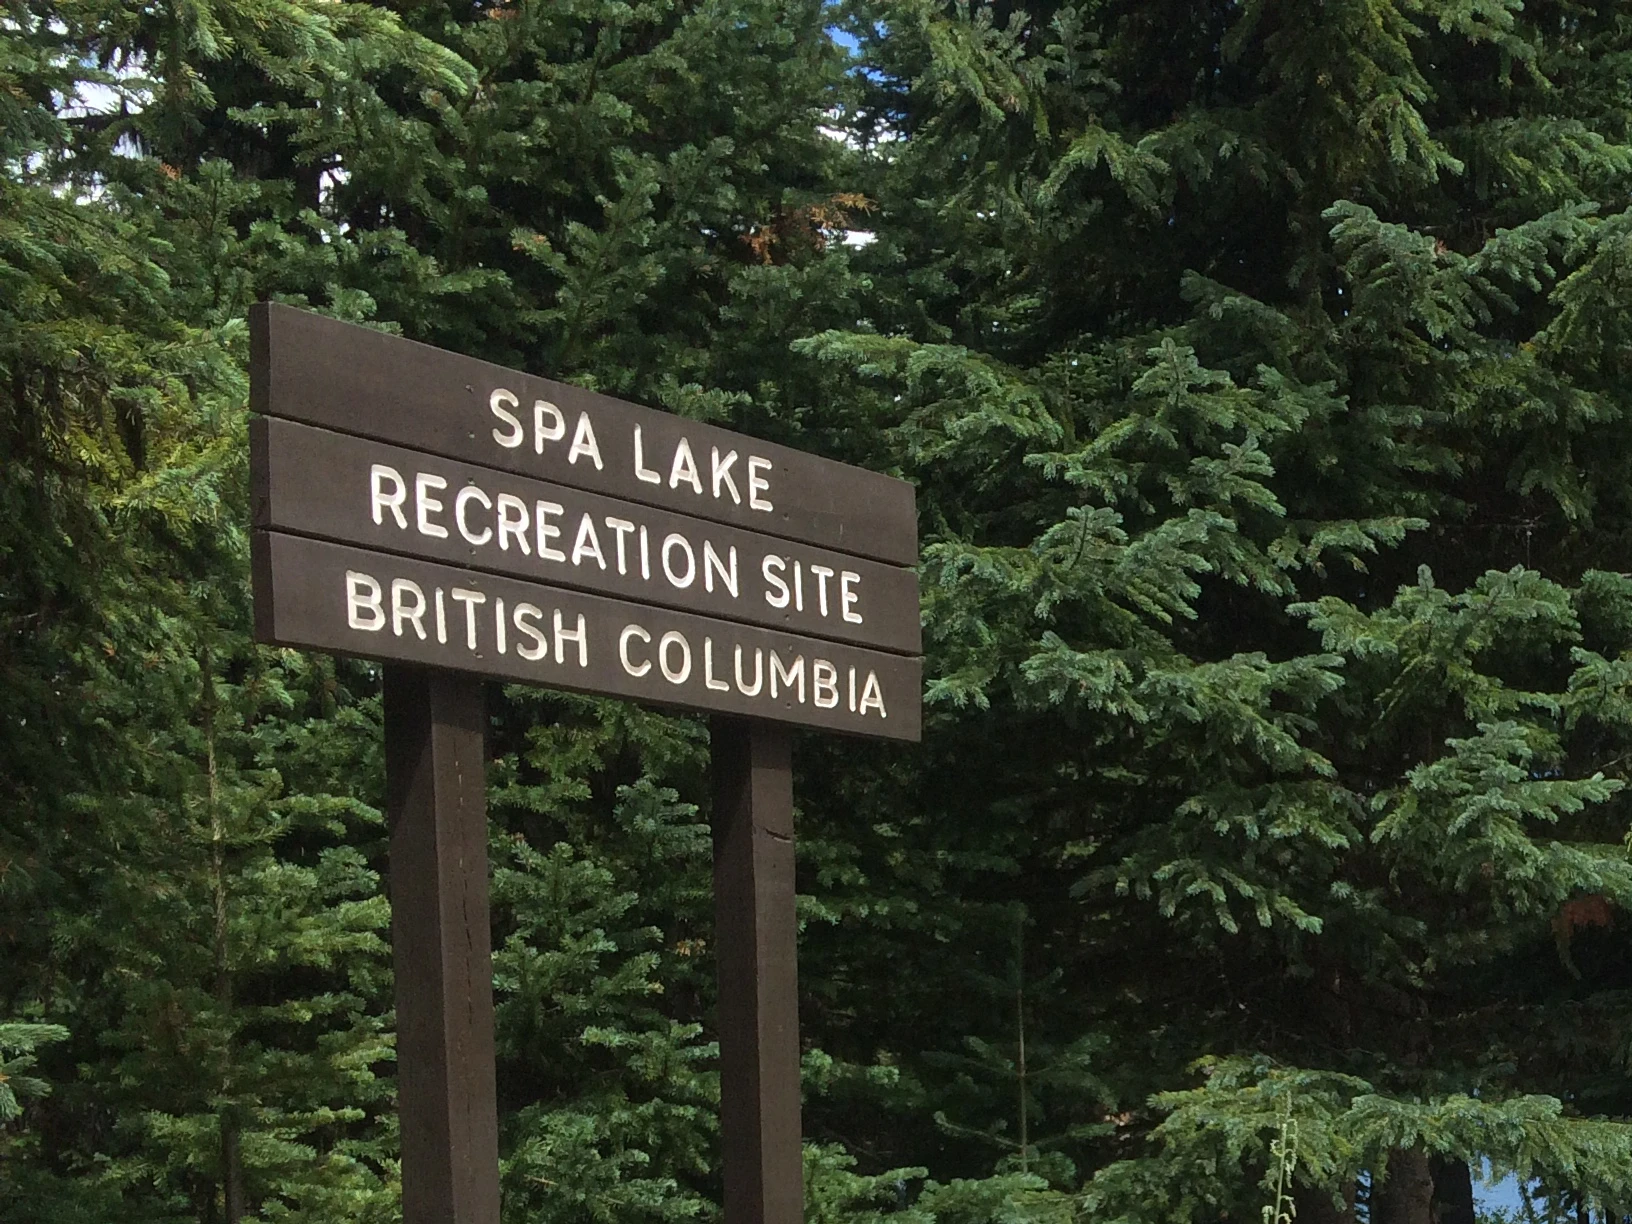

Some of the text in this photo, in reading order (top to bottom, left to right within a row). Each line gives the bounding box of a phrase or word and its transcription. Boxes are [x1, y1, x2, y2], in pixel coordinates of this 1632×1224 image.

[490, 389, 774, 513] SPA LAKE
[370, 463, 864, 625] RECREATION SITE
[344, 569, 888, 720] BRITISH COLUMBIA
